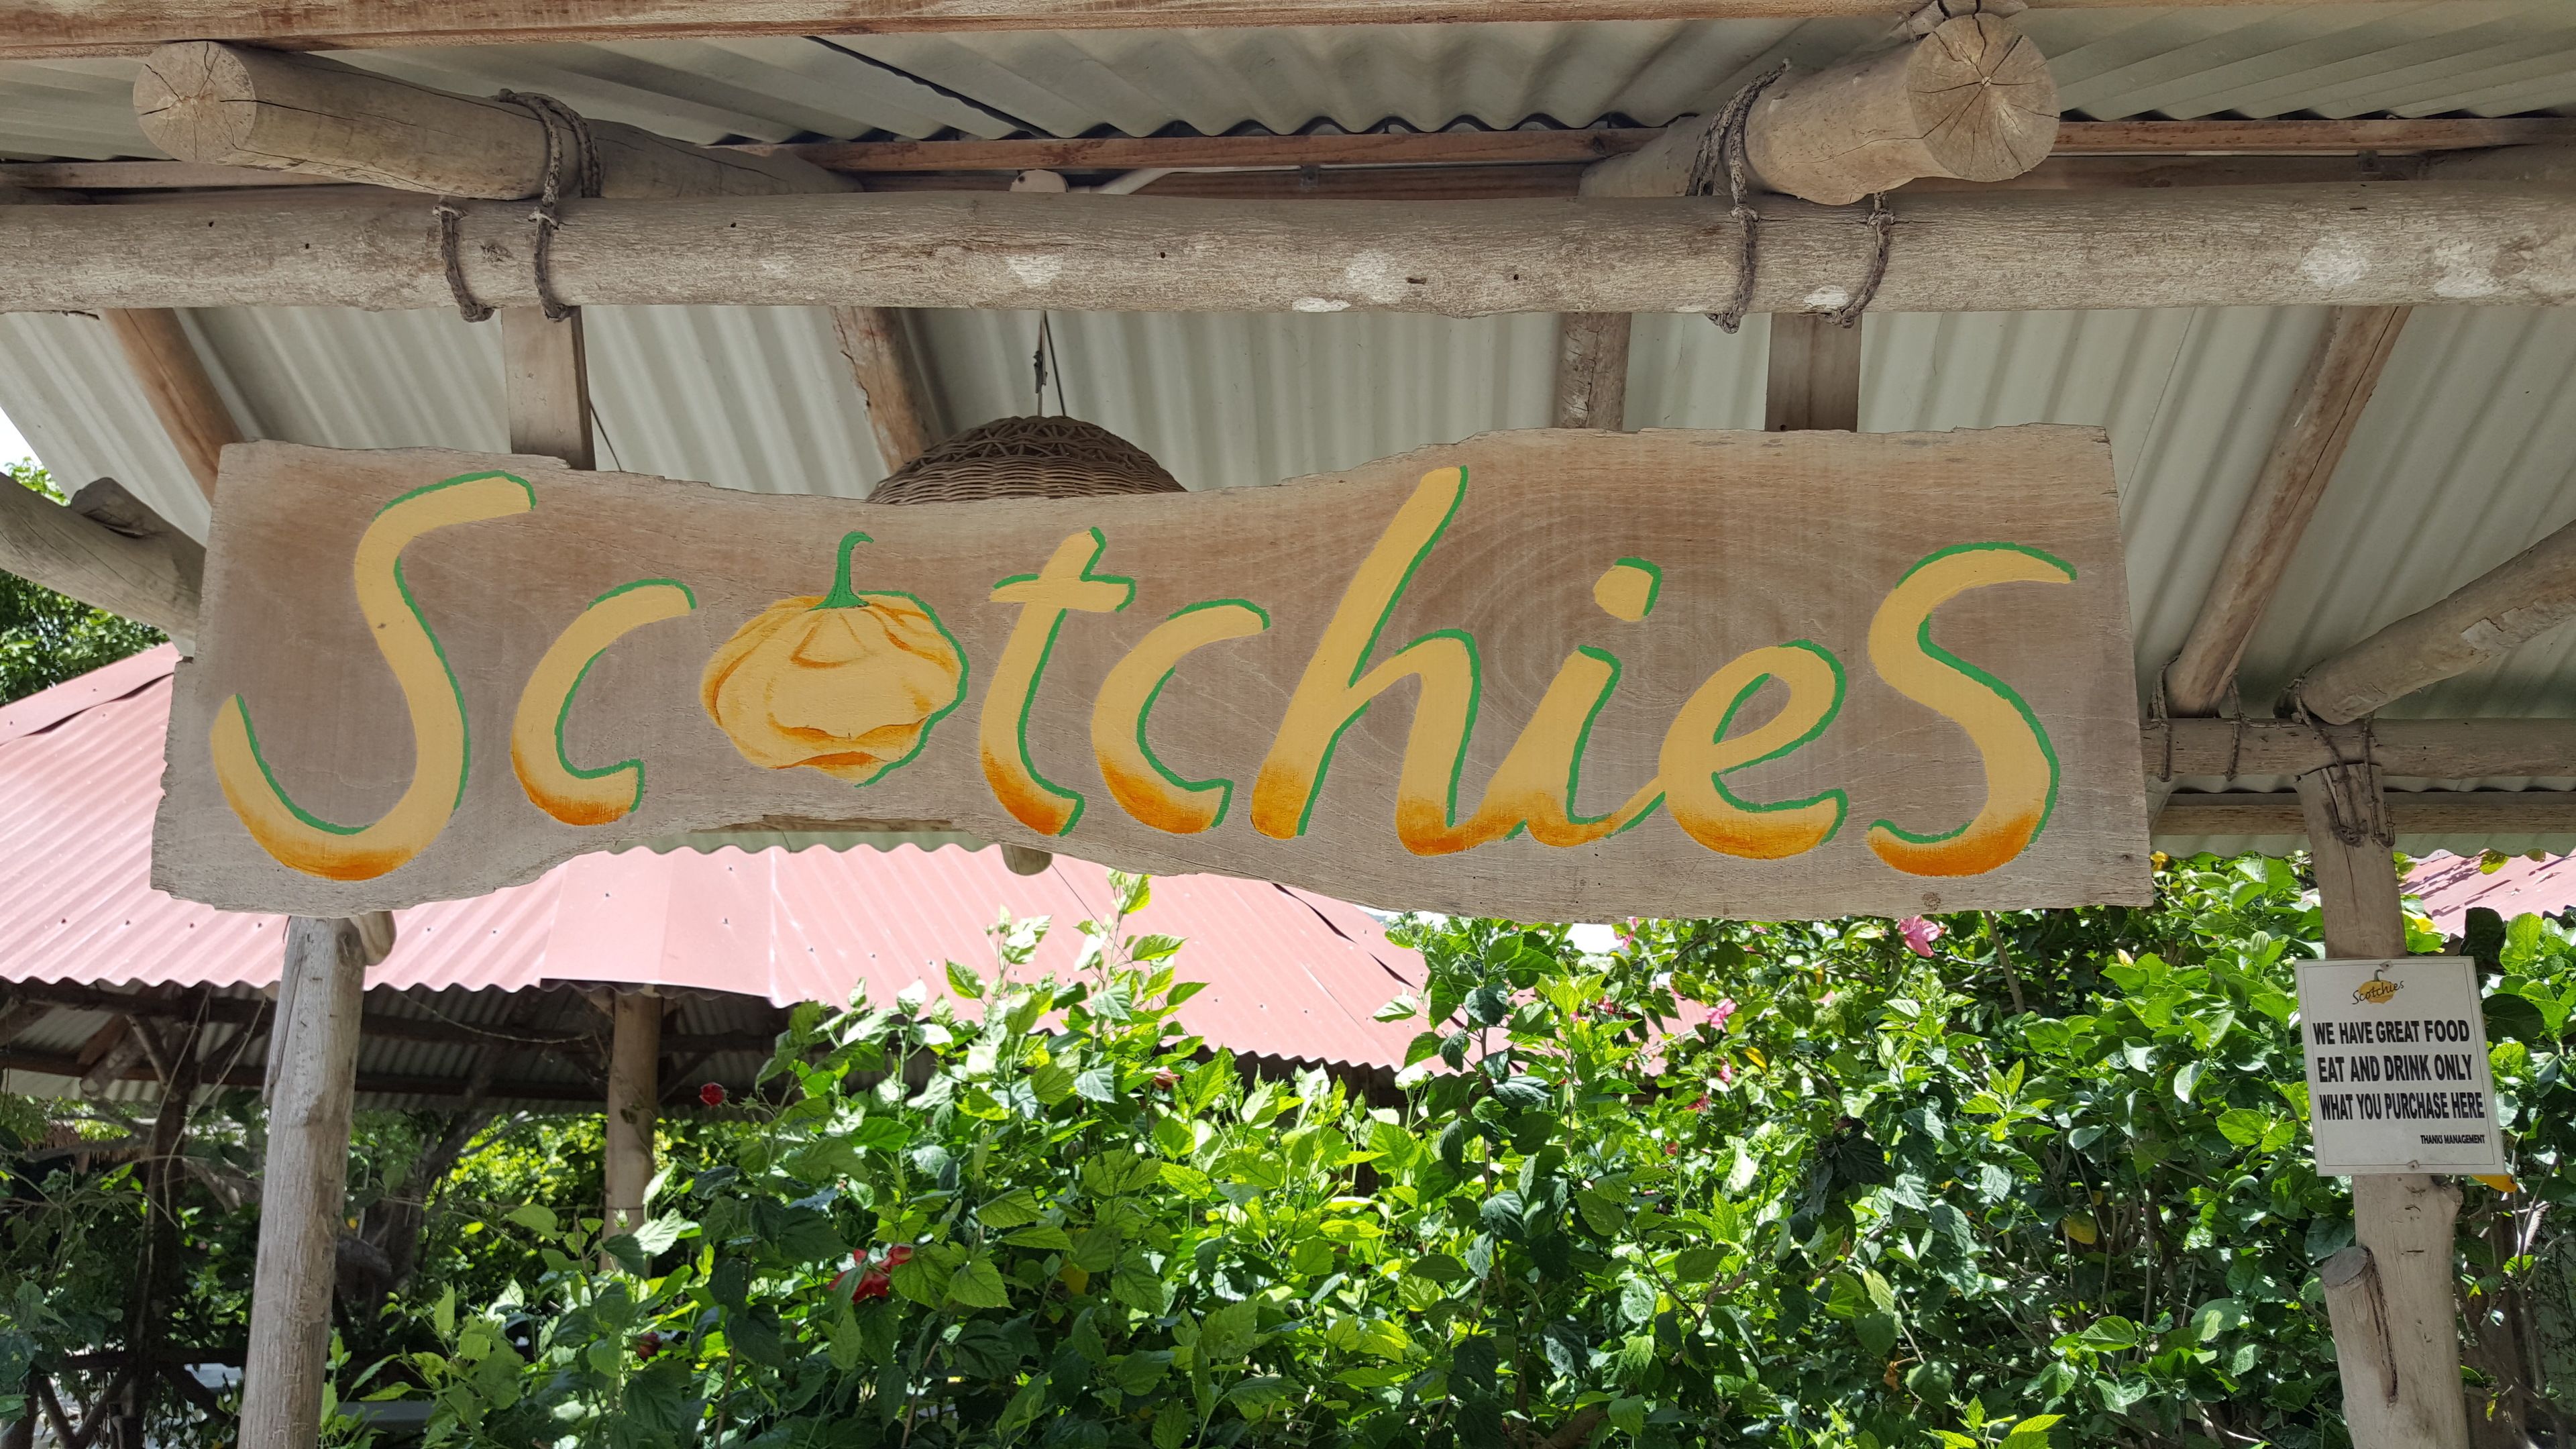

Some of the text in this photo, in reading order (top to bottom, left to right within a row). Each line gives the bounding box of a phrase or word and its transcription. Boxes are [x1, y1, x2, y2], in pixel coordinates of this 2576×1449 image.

[2352, 980, 2404, 1005] Scotchies
[2313, 1020, 2470, 1045] WE HAVE GREAT FOOD
[2317, 1054, 2472, 1083] EAT AND DRINK ONLY
[2319, 1092, 2485, 1120] WHAT YOU PURCHASE HERE
[2420, 1134, 2485, 1144] THANKS MANAGEMENT
